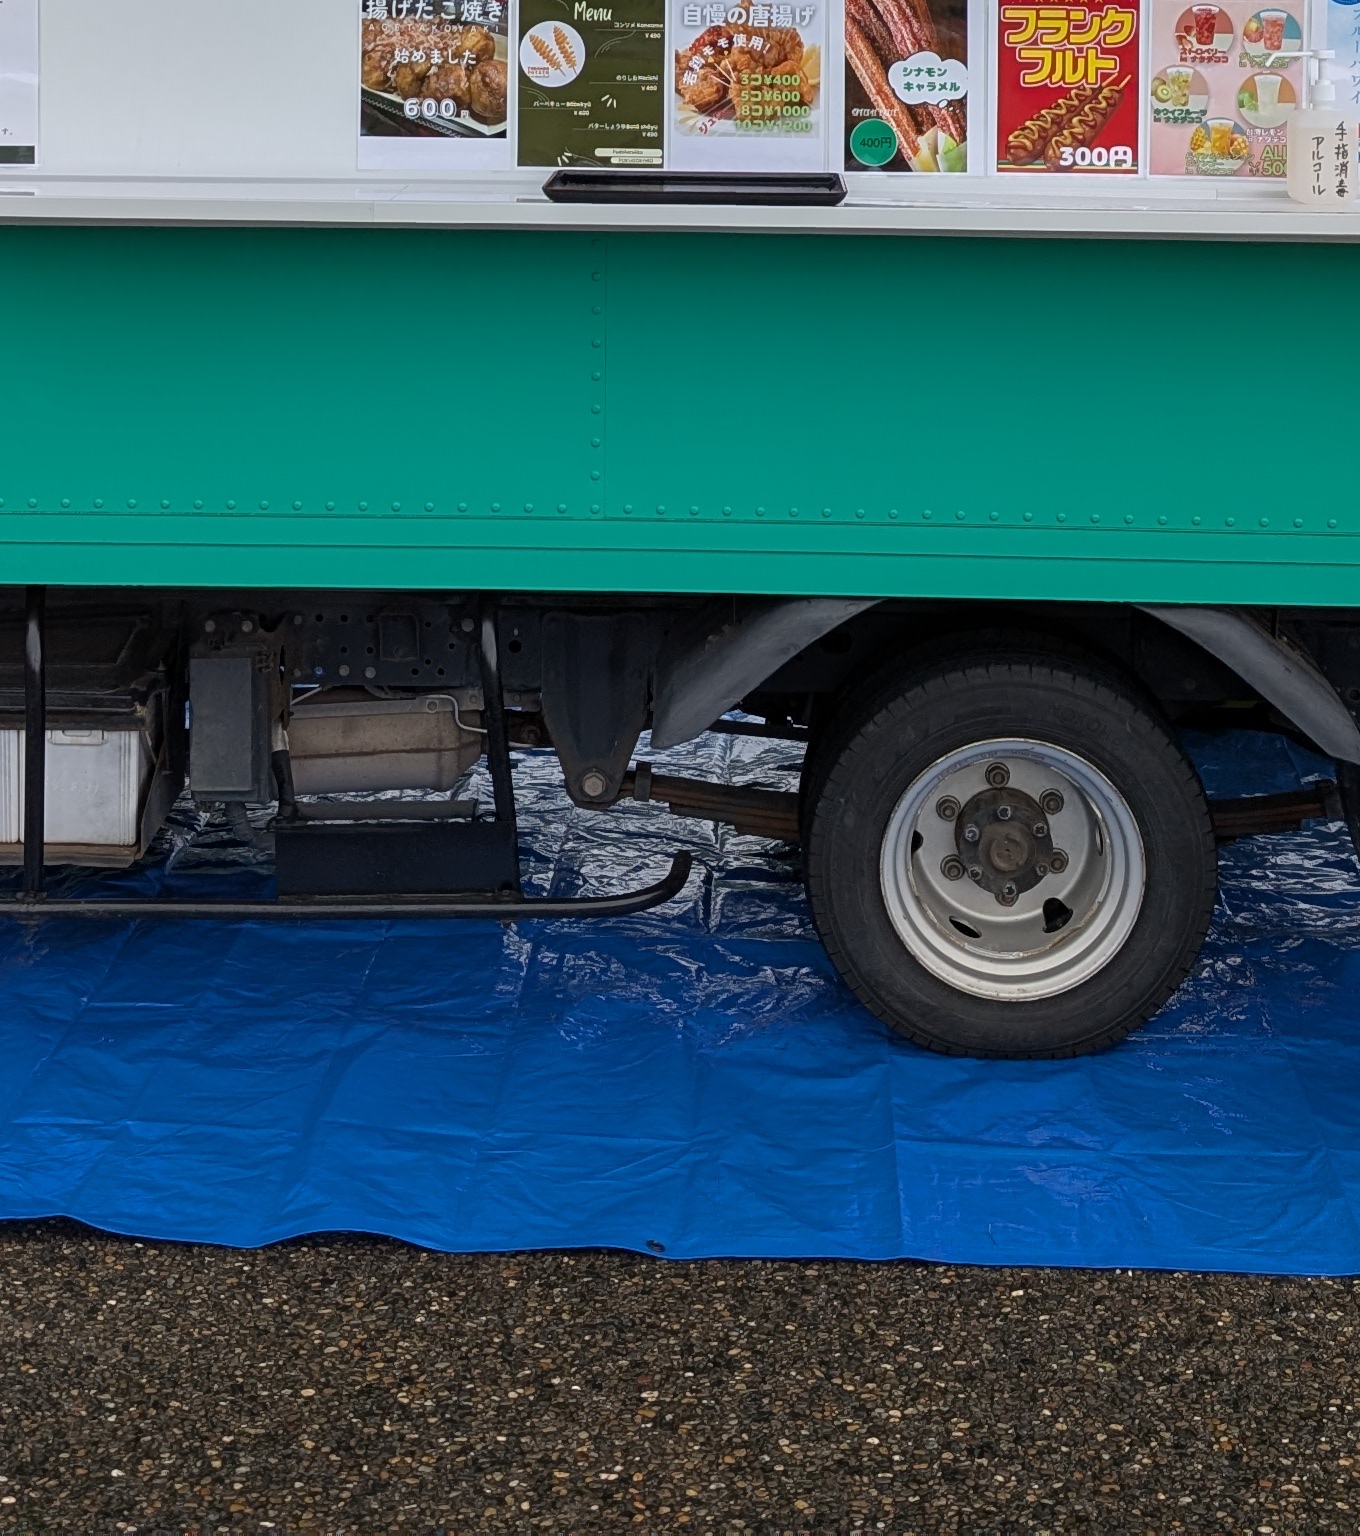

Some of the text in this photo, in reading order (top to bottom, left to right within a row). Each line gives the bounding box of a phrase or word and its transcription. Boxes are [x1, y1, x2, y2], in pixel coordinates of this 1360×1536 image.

[573, 1, 613, 22] Menu
[682, 3, 816, 28] 自慢の唐揚げ
[1001, 5, 1136, 47] フランク
[394, 49, 477, 65] 始めました
[1016, 46, 1119, 87] フルト
[901, 67, 948, 77] シナモン
[903, 80, 961, 93] キャラメル
[860, 136, 892, 148] 400円
[1059, 146, 1133, 168] 300円
[1311, 135, 1327, 196] アルコール
